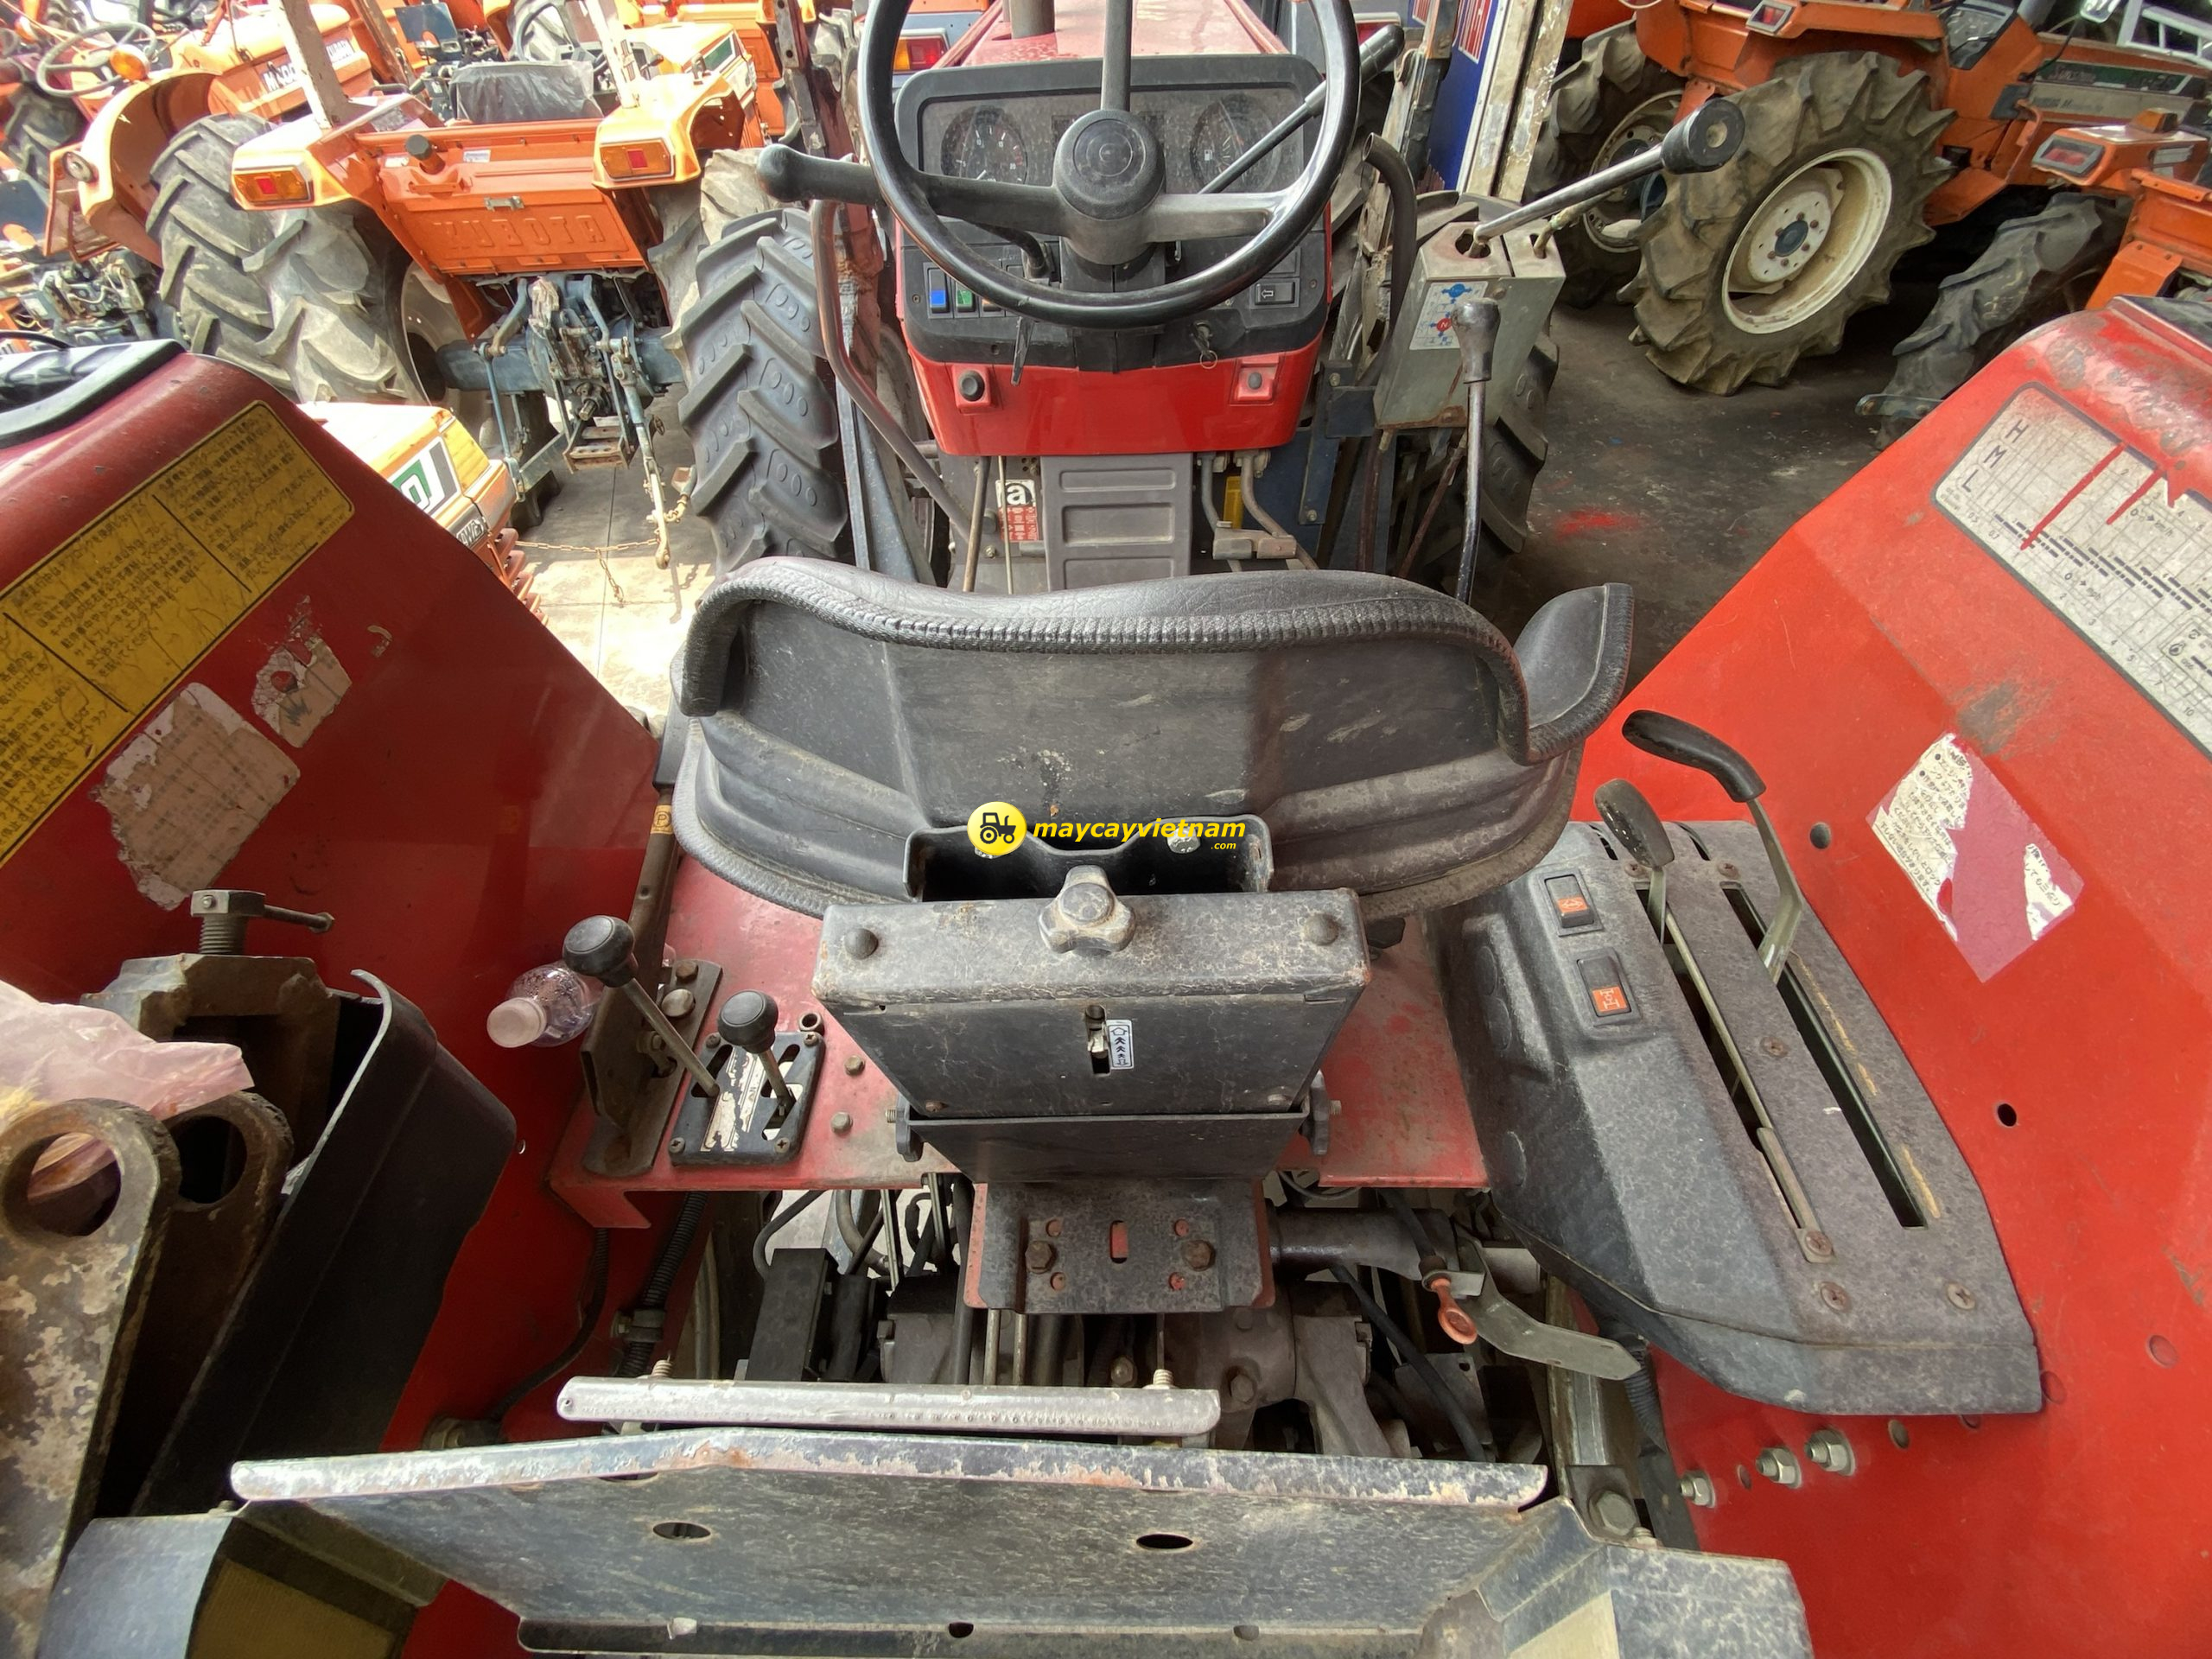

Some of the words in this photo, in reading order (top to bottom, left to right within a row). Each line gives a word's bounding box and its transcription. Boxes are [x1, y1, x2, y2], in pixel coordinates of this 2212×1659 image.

[433, 214, 606, 251] KUBOTA
[2005, 419, 2029, 443] H
[1984, 445, 2007, 468] M
[1962, 469, 1979, 493] L
[2183, 707, 2195, 717] 10
